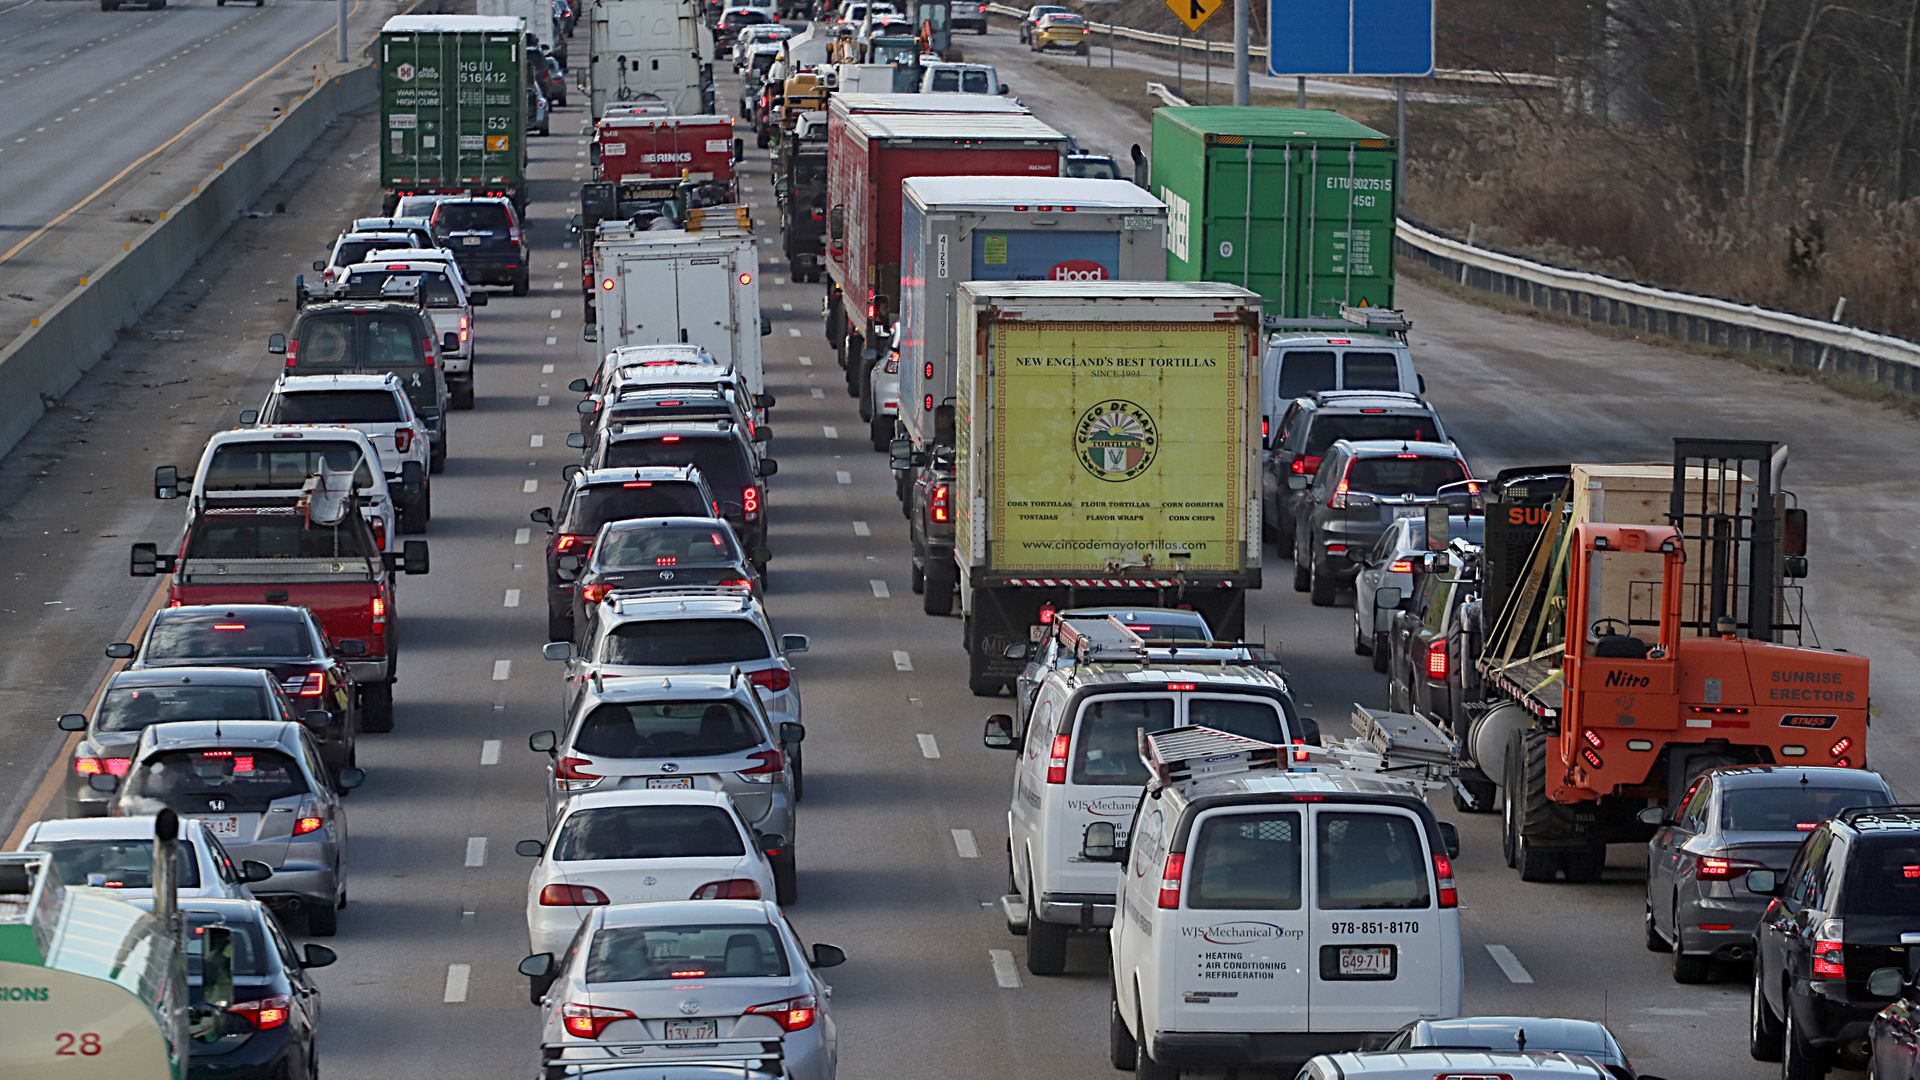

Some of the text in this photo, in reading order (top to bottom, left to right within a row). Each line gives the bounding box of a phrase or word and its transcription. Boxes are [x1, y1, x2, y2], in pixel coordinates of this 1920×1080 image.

[396, 98, 440, 106] HIGH CUBE
[1326, 177, 1351, 189] EITU
[1352, 195, 1376, 207] 45G1
[938, 234, 947, 278] 41290
[1056, 268, 1101, 281] Hood
[1016, 357, 1216, 368] NEW ENGLAND'S BEST TORTILLAS
[1091, 369, 1119, 378] SINCE
[1078, 402, 1155, 446] CINCO DE MAYO
[1092, 440, 1141, 448] TORTILLAS
[1022, 538, 1207, 551] www.cincodemayotortillas.com
[1604, 670, 1650, 688] Nitro
[1771, 671, 1842, 685] SUNRISE
[1769, 688, 1856, 702] ERECTORS
[1067, 800, 1088, 811] WJS
[1181, 926, 1304, 941] WJS Mechanical Corp
[1331, 921, 1419, 934] 978-851-8170
[1205, 952, 1243, 960] HEATING
[1223, 962, 1287, 970] CONDITIONING
[1205, 971, 1274, 980] REFRIGERATION
[55, 1032, 102, 1057] 28
